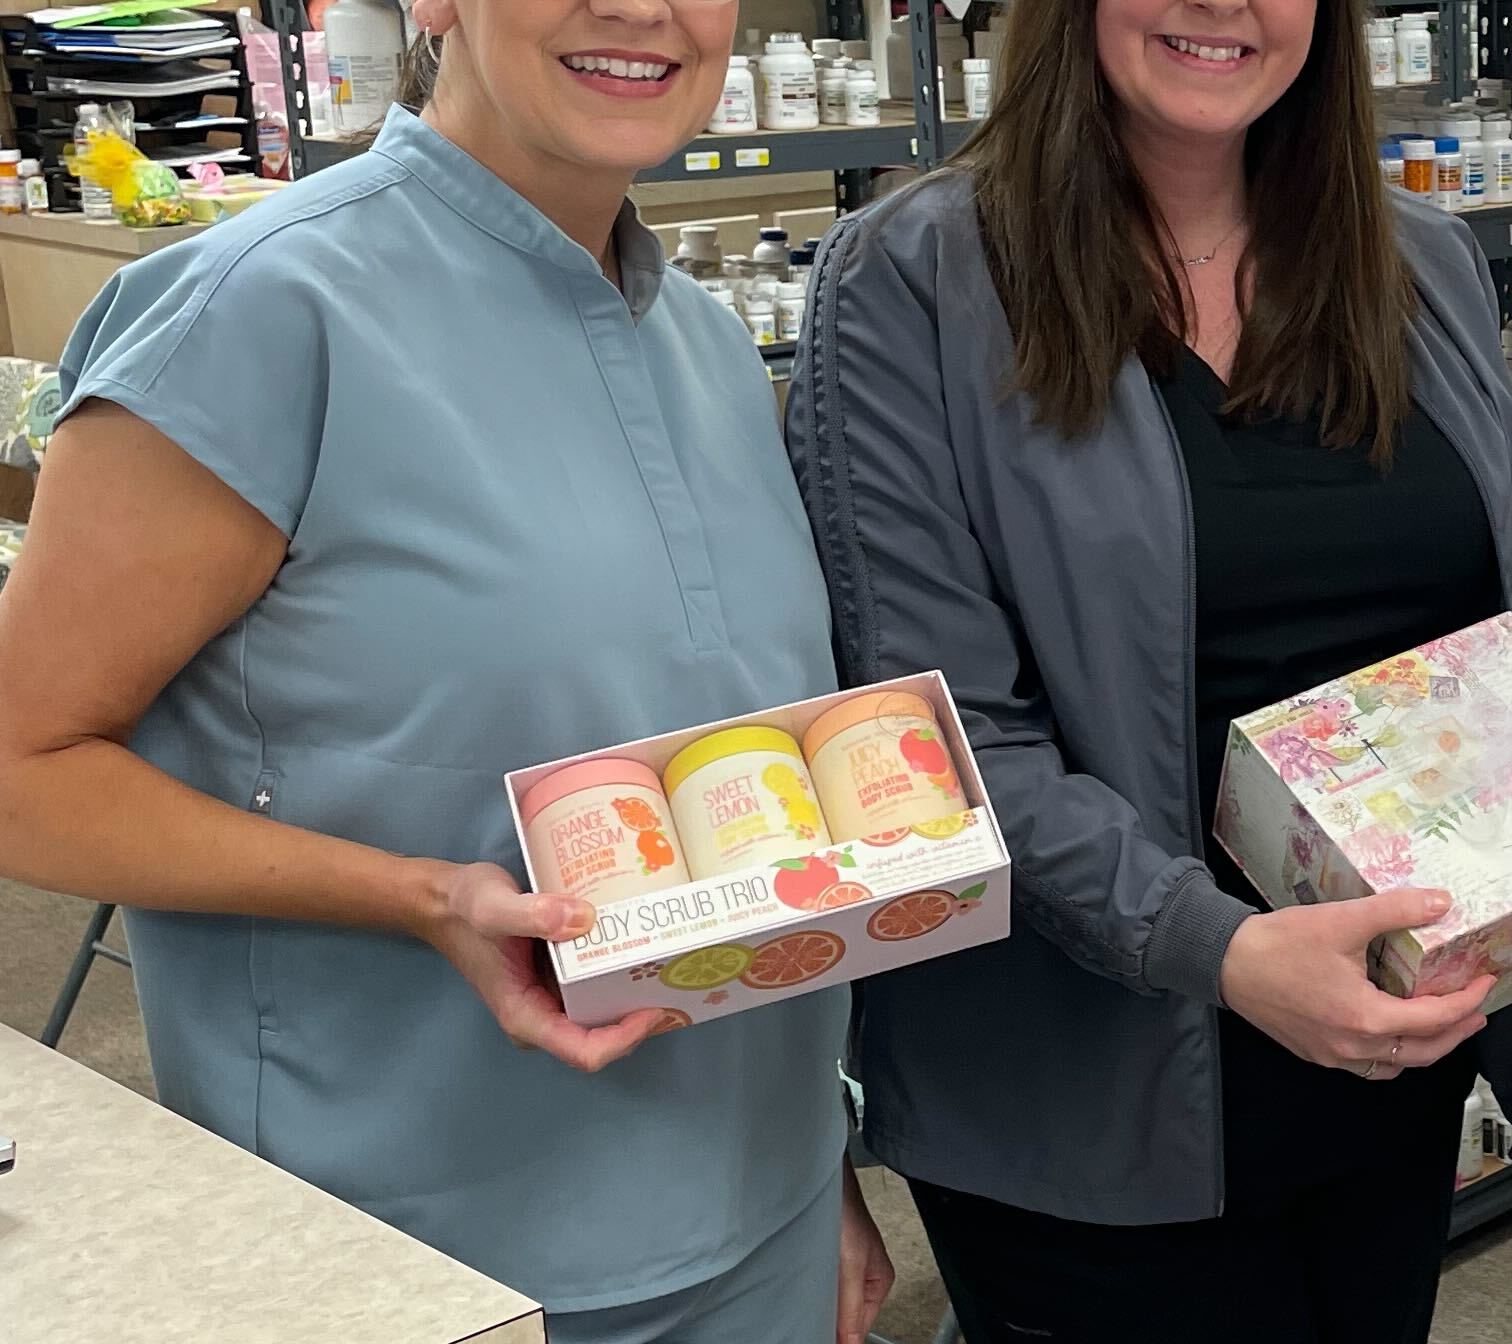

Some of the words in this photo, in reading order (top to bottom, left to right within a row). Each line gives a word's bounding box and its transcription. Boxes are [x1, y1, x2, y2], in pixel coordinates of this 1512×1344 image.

[703, 775, 754, 810] SWEET
[551, 809, 608, 846] ORANGE
[709, 796, 760, 829] LEMON
[555, 827, 625, 866] BLOSSOM
[637, 890, 715, 933] SCRUB
[715, 876, 770, 910] TRIO
